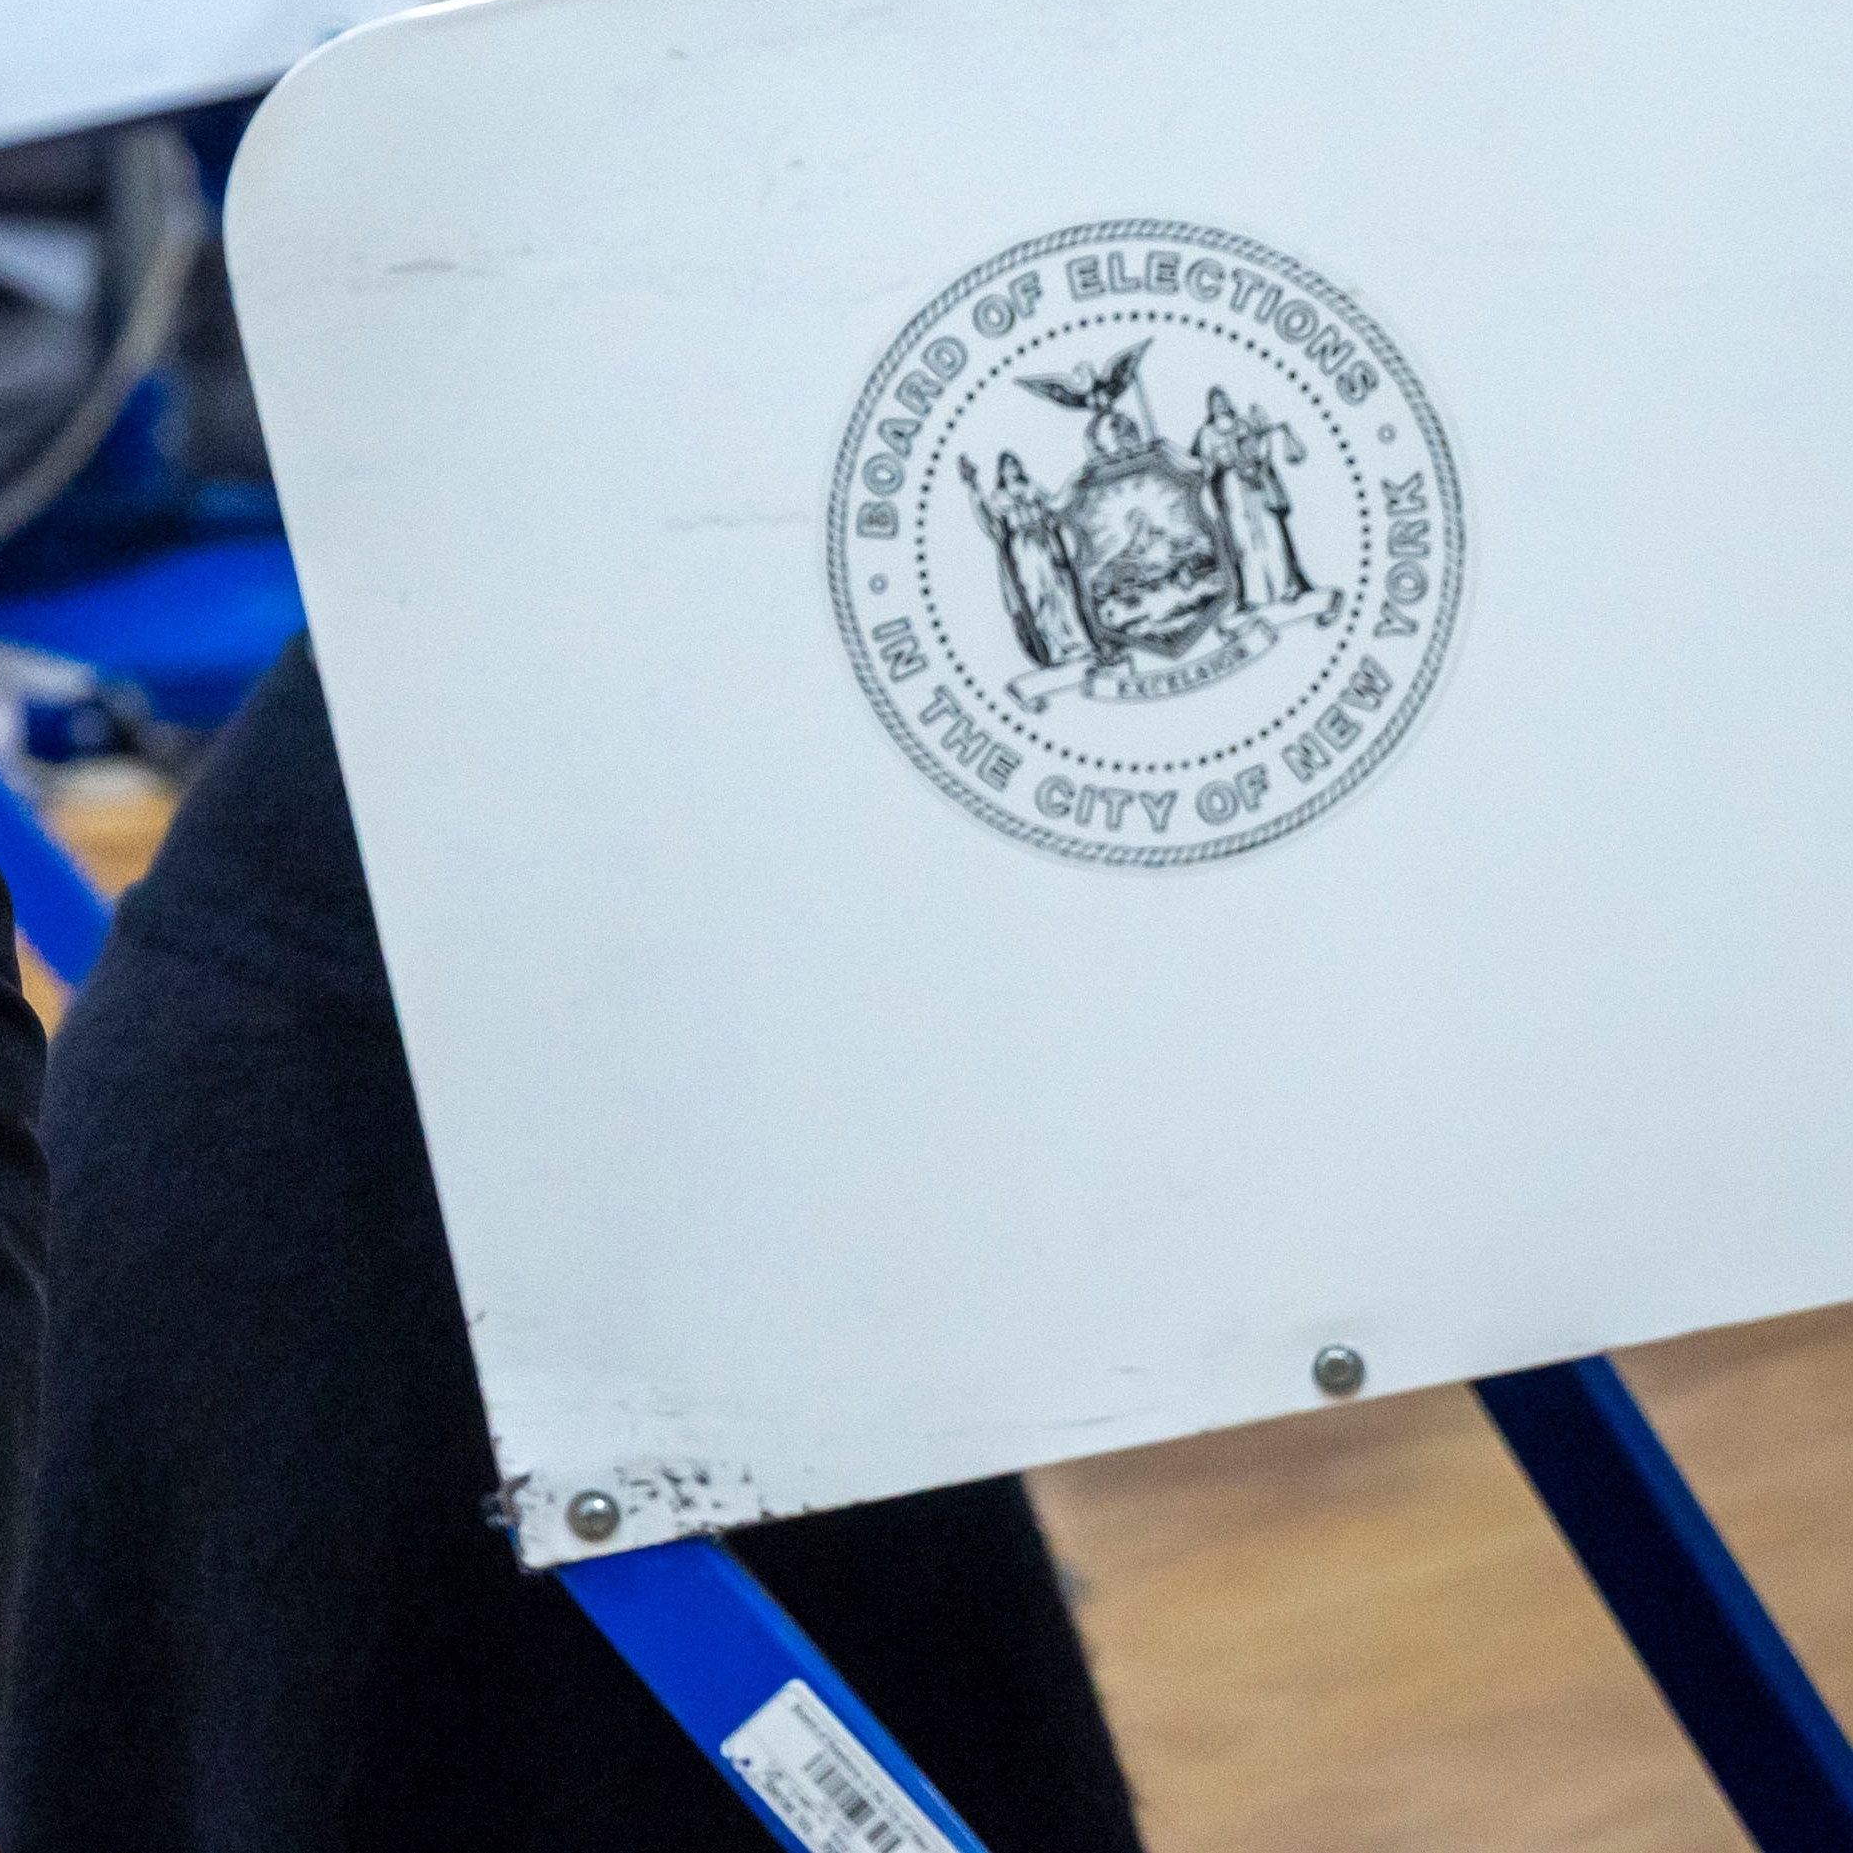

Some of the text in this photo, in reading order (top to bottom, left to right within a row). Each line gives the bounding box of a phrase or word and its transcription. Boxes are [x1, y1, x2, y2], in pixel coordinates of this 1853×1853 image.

[856, 250, 1381, 539] BOARD OF ELECTIONS
[870, 616, 929, 683] IN
[918, 685, 1023, 792] THE
[1034, 774, 1177, 833] CITY
[1194, 763, 1271, 826] OF
[1280, 653, 1395, 783] NEW
[1374, 470, 1432, 638] YORK
